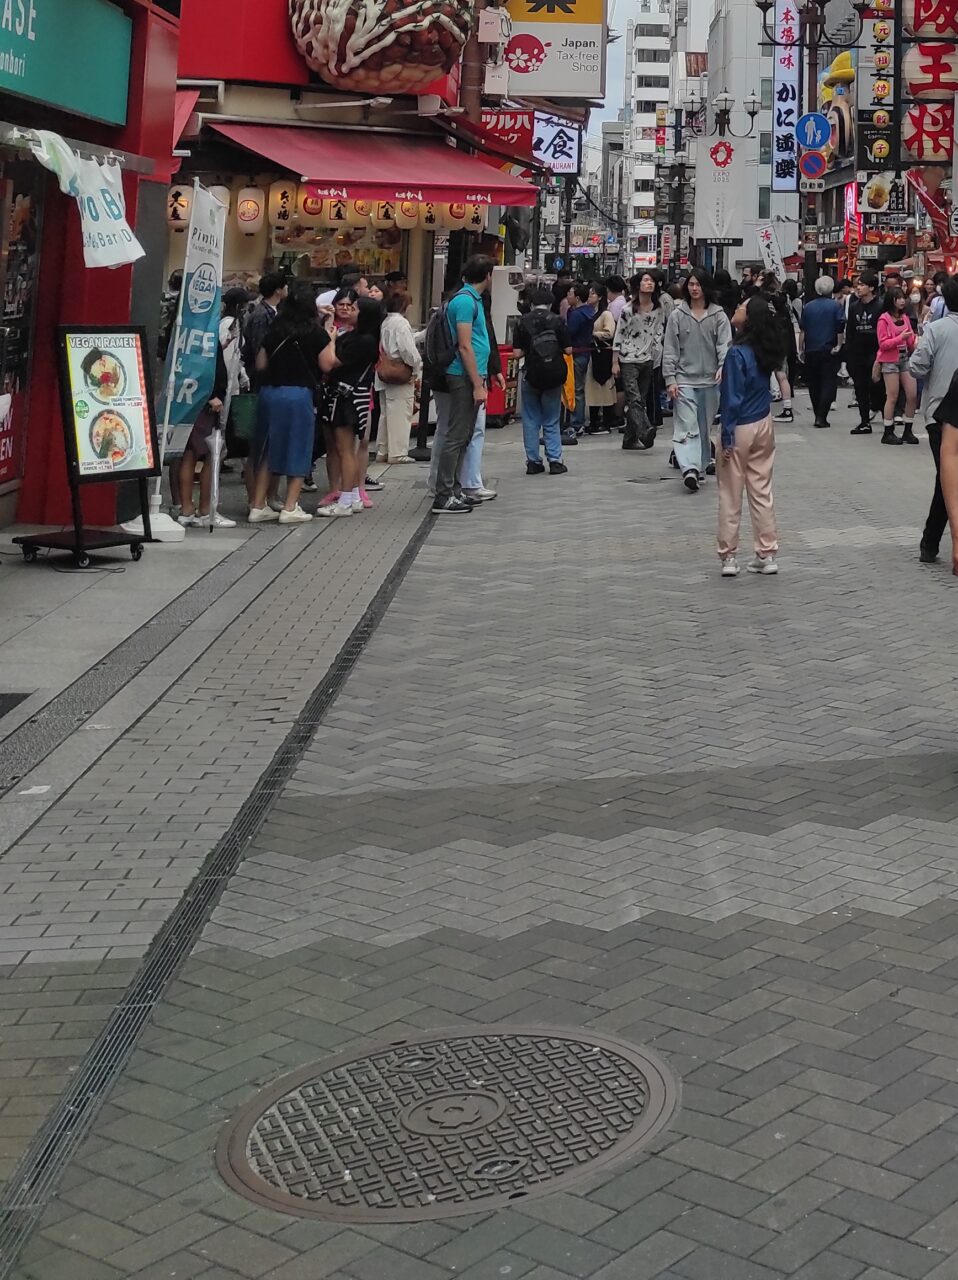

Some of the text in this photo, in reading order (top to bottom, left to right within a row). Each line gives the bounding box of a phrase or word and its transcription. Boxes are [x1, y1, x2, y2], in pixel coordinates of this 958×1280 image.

[561, 38, 599, 49] Japan.
[779, 7, 795, 70] 本場の味
[556, 51, 599, 61] Tax-free
[572, 63, 599, 72] Shop
[198, 269, 214, 282] ALL
[70, 336, 136, 348] VEGAN RAMEN
[176, 327, 215, 358] AFE
